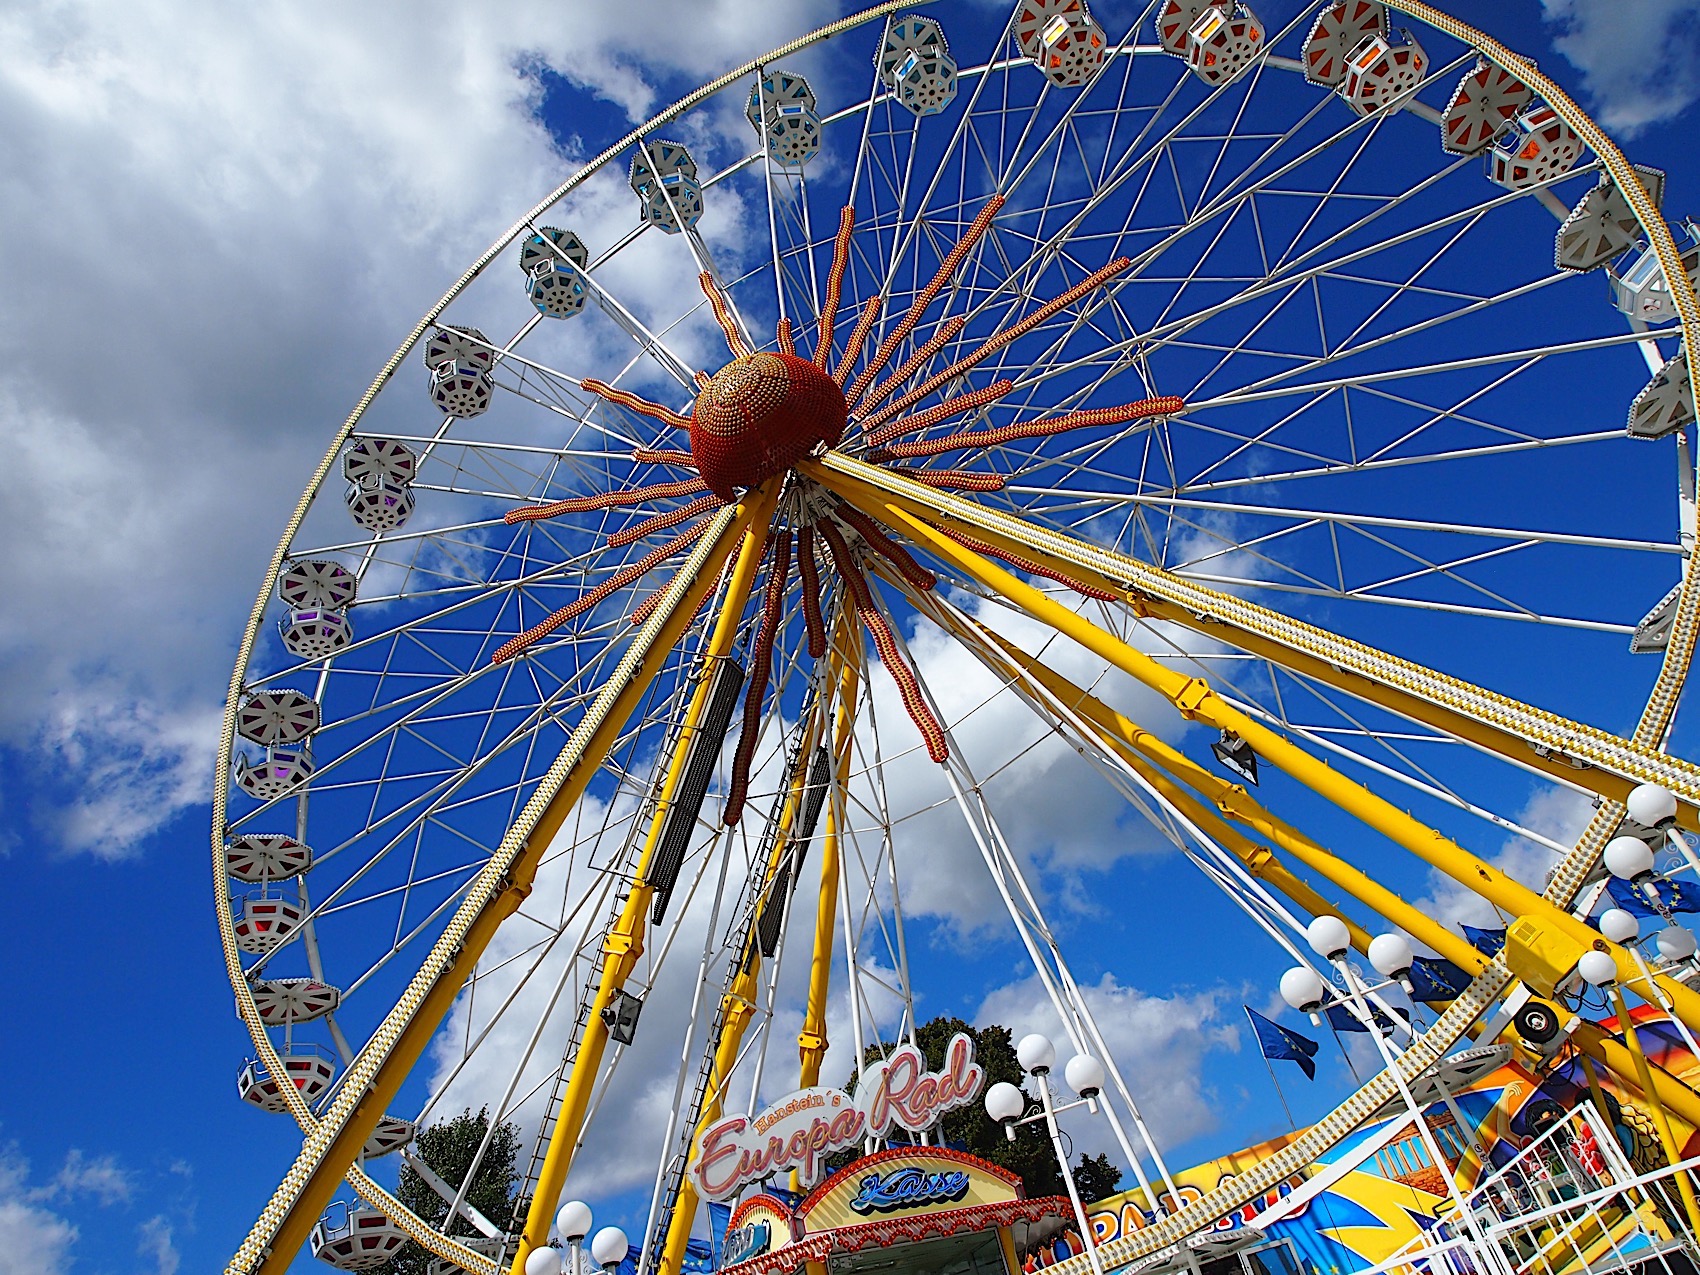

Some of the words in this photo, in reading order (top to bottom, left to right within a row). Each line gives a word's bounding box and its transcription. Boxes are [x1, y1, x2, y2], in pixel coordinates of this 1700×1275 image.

[694, 1108, 865, 1195] Europa
[870, 1038, 978, 1130] Rad
[849, 1166, 970, 1213] Kasse
